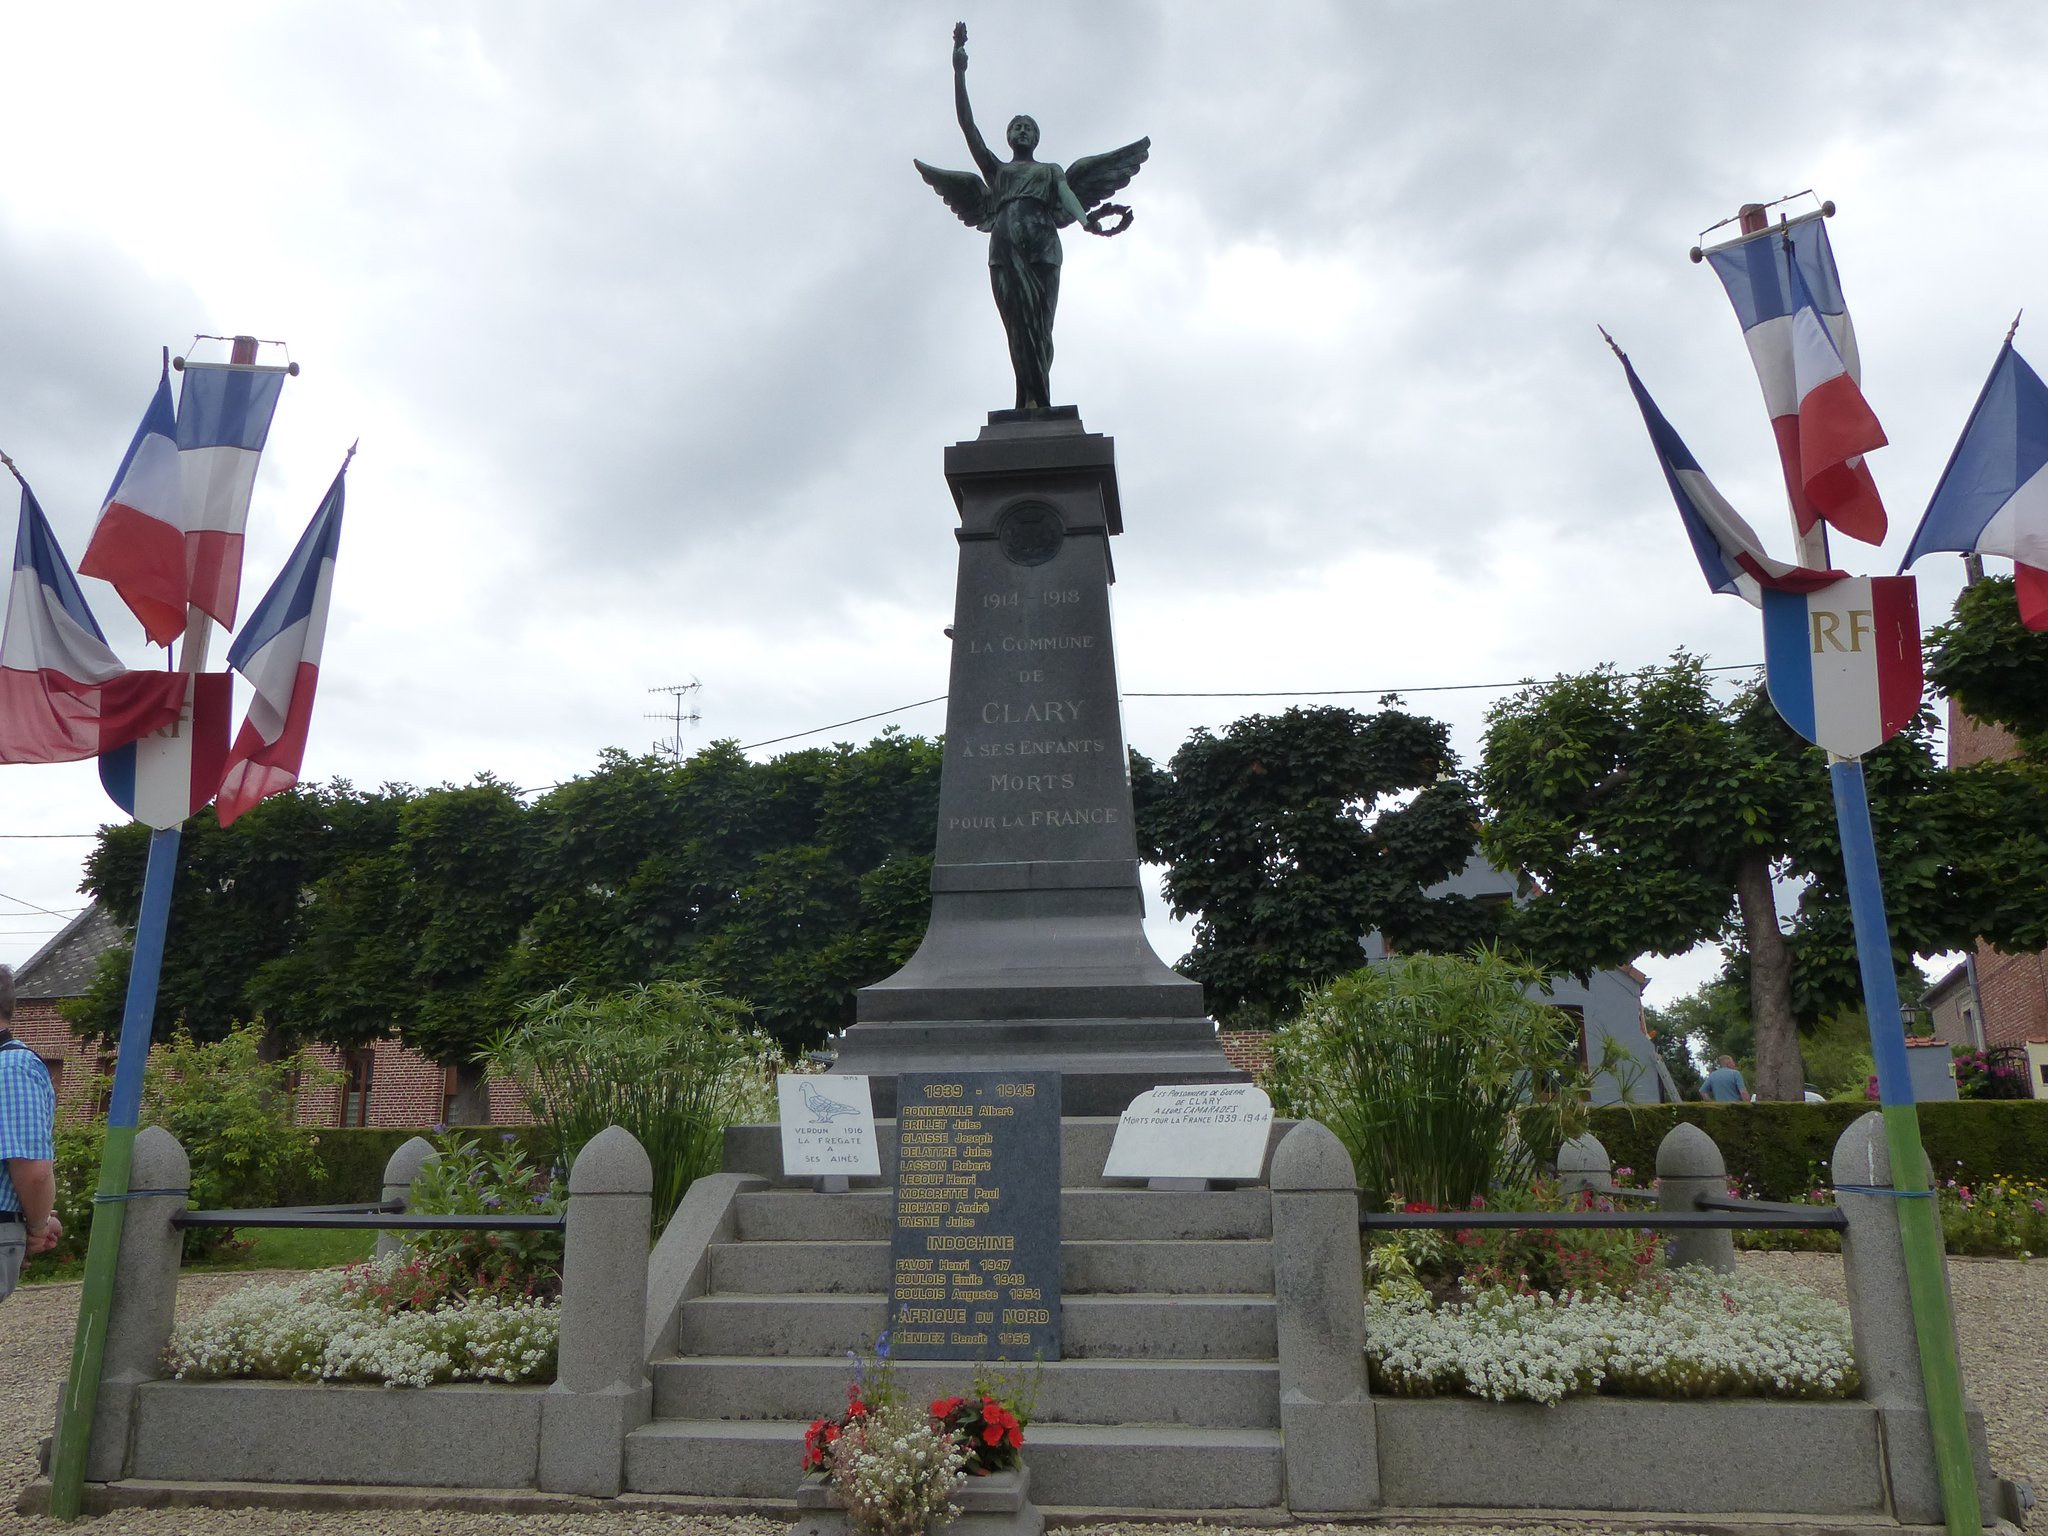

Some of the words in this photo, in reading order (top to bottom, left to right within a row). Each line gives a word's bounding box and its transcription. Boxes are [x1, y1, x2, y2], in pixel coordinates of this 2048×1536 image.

[983, 592, 1018, 608] 1914
[1043, 590, 1080, 605] 1918
[1810, 610, 1872, 653] RF
[970, 641, 993, 654] LA
[1002, 636, 1094, 651] COMMUNE
[1019, 670, 1044, 683] DE
[982, 700, 1087, 724] CLARY
[980, 743, 1014, 757] SES
[1020, 739, 1105, 755] ENFANTS
[991, 774, 1076, 792] MORTS
[950, 816, 996, 829] POUR
[1002, 815, 1024, 827] LA
[1031, 808, 1118, 827] FRANCE
[924, 1084, 963, 1098] 1939
[996, 1084, 1035, 1098] 1945
[903, 1106, 973, 1116] BONNEVILLE
[979, 1106, 1014, 1116] Albert
[1183, 1105, 1238, 1114] CAMARADES
[903, 1120, 947, 1130] BRILLET
[953, 1120, 981, 1130] Jules
[1123, 1116, 1148, 1124] MORTS
[1182, 1115, 1211, 1123] FRANCE
[902, 1133, 949, 1144] CLAISSE
[955, 1133, 993, 1145] Joseph
[902, 1147, 956, 1157] DELATTRE
[963, 1147, 992, 1157] Jules
[901, 1161, 946, 1171] LASSON
[953, 1161, 992, 1171] Robert
[900, 1174, 944, 1185] LECOUF
[946, 1175, 976, 1185] Henri
[900, 1188, 968, 1199] MORCRETTE
[975, 1188, 999, 1199] Paul
[899, 1202, 949, 1213] RICHARD
[956, 1202, 989, 1213] André
[898, 1216, 940, 1227] TAISNE
[946, 1216, 975, 1227] Jules
[928, 1236, 1014, 1251] INDOCHINE
[896, 1259, 933, 1271] FAVOT
[939, 1260, 970, 1271] Henri
[980, 1260, 1011, 1271] 1947
[953, 1274, 983, 1285] Emile
[993, 1274, 1025, 1285] 1948
[952, 1289, 998, 1302] Auguste
[1009, 1289, 1041, 1300] 1954
[899, 1308, 966, 1323] AFRIQUE
[976, 1311, 993, 1323] DU
[1003, 1309, 1049, 1324] NORD
[893, 1332, 945, 1344] MENDEZ
[999, 1333, 1031, 1344] 1956
